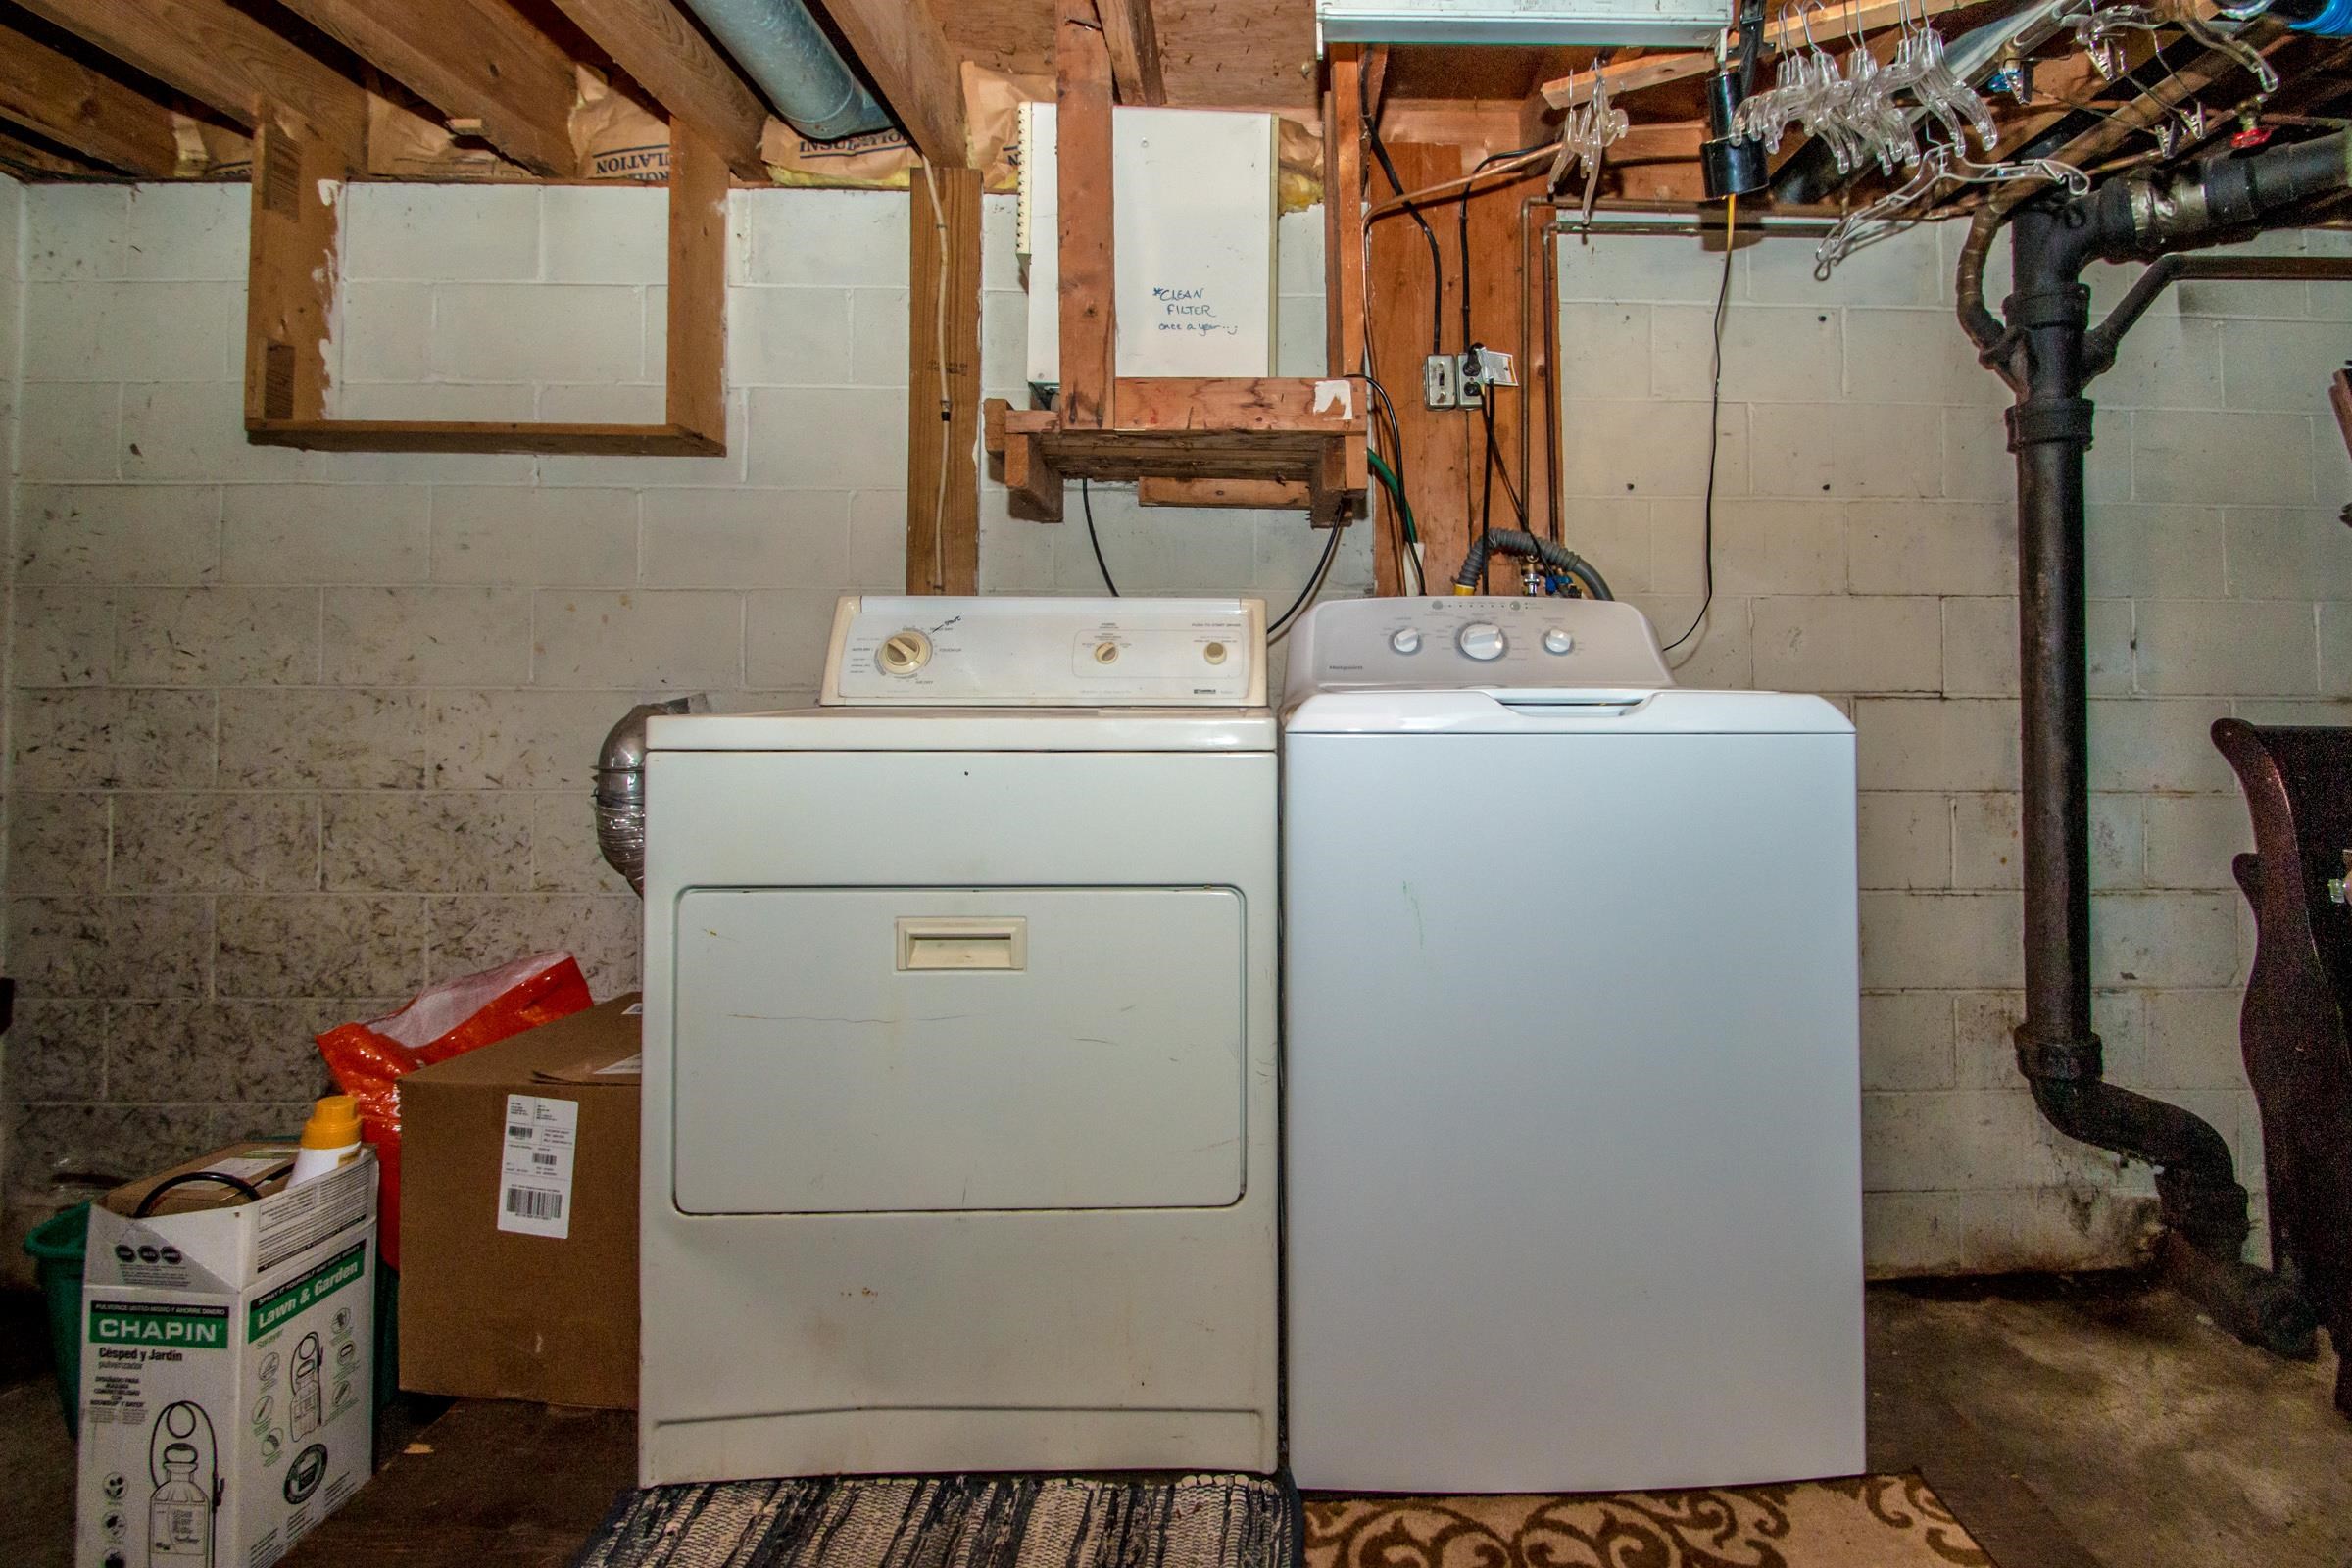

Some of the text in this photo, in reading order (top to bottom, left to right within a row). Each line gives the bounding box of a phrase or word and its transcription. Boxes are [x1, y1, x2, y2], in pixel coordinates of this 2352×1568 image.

[1167, 304, 1216, 317] FILTER
[259, 1261, 358, 1328] Lawn & Garden
[99, 1318, 217, 1342] CHAPIN
[99, 1347, 183, 1362] Césped y Jardín
